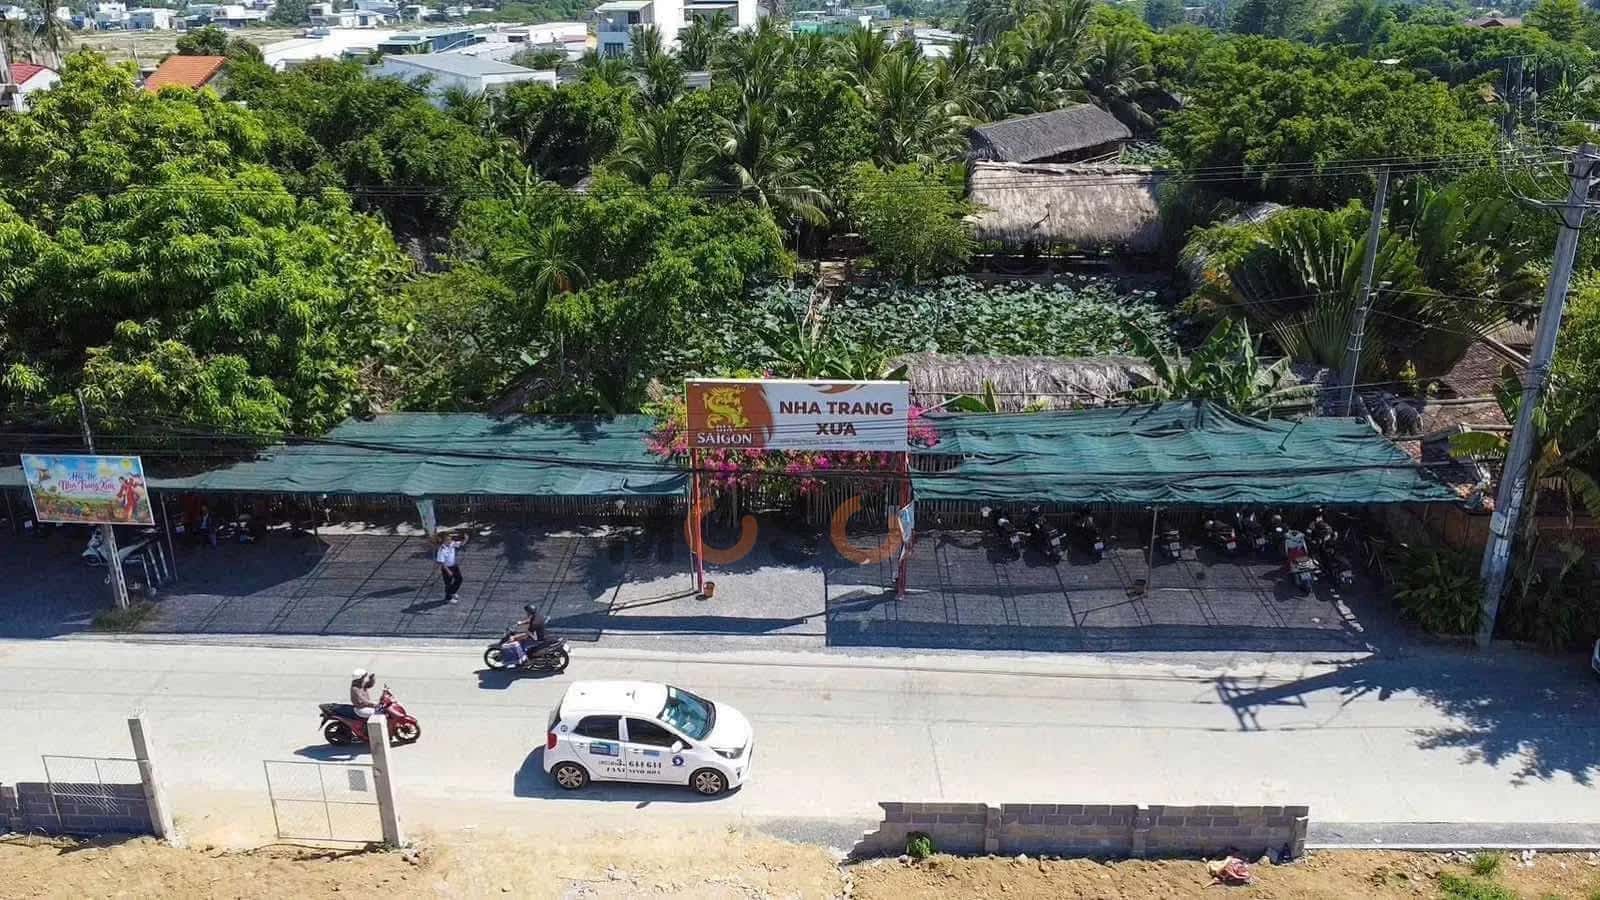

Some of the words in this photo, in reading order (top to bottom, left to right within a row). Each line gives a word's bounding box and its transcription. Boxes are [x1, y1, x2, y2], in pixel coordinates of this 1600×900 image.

[779, 401, 821, 414] NHA
[826, 401, 894, 415] TRANG
[697, 432, 752, 444] SAIGON
